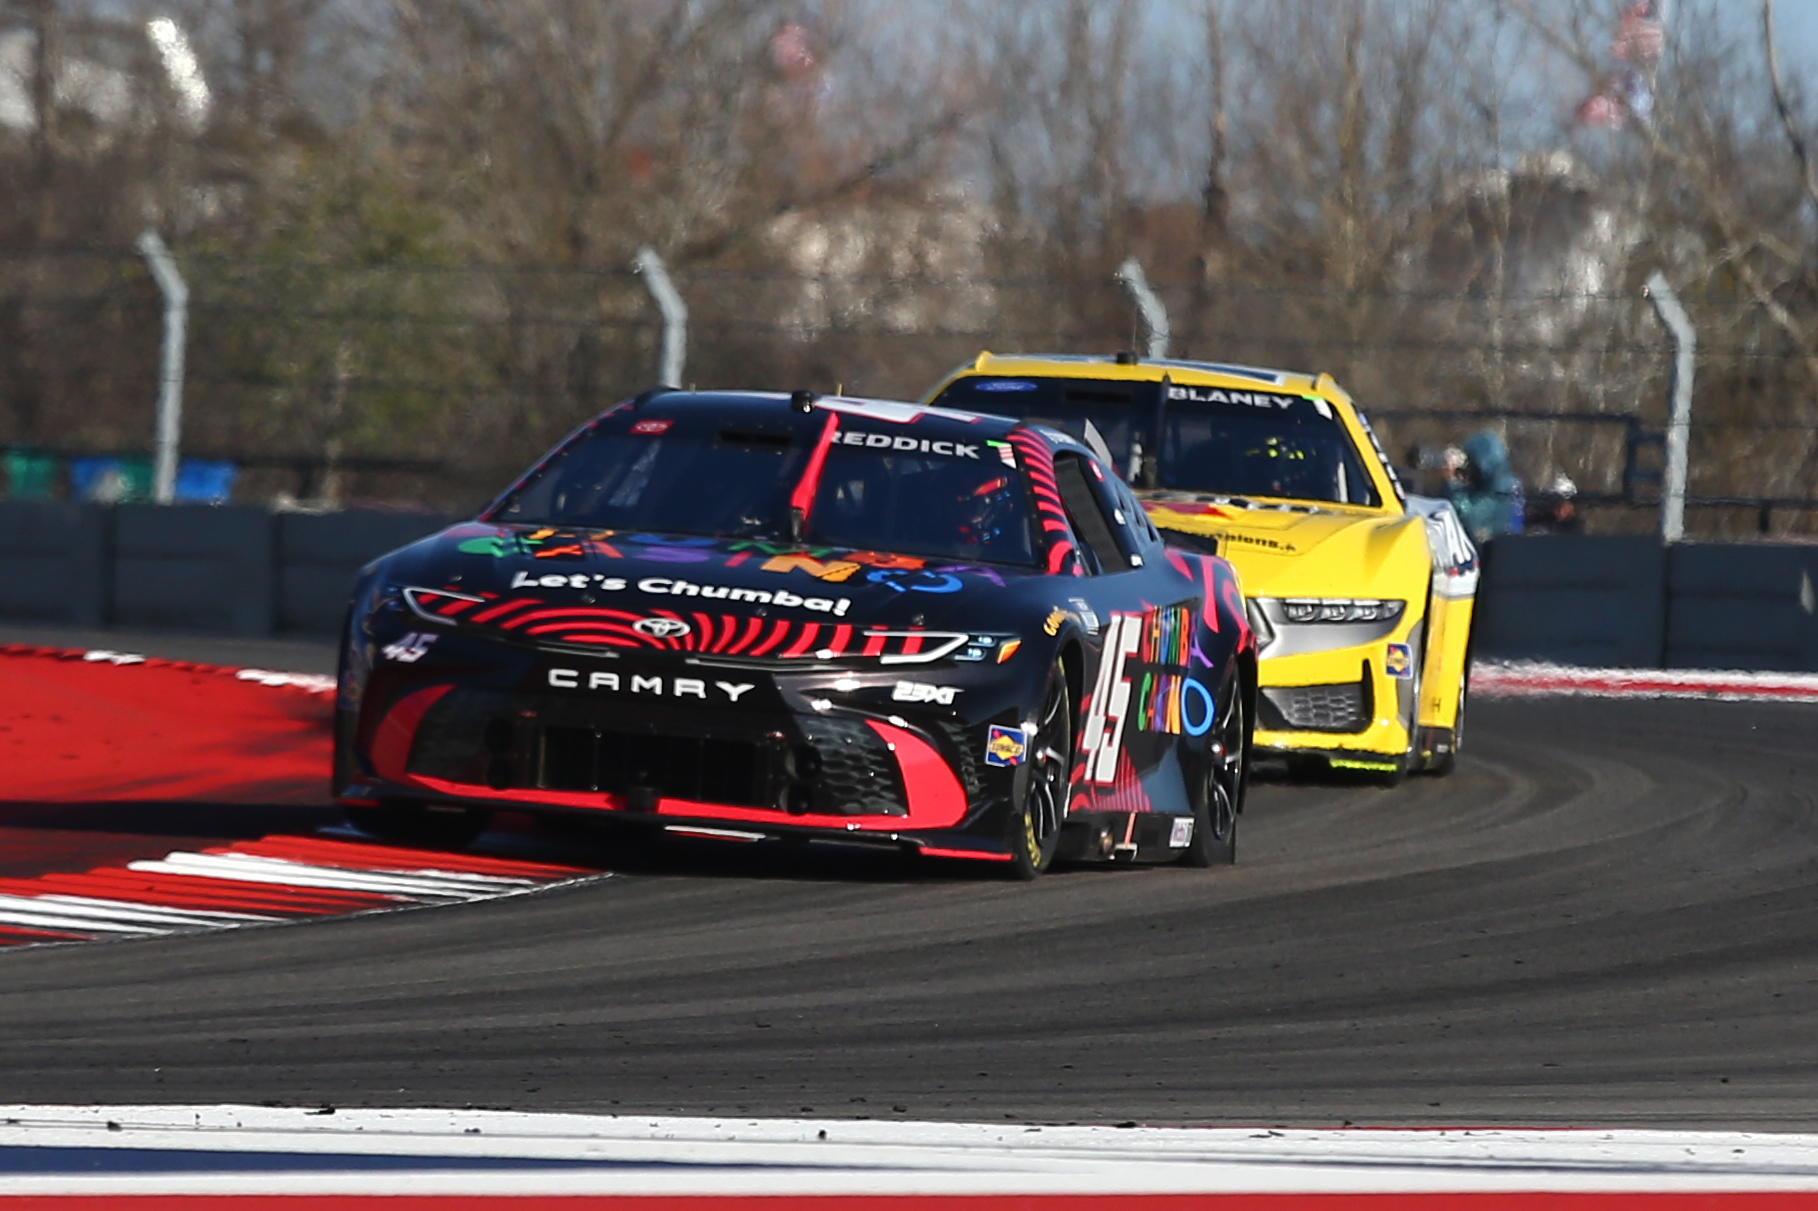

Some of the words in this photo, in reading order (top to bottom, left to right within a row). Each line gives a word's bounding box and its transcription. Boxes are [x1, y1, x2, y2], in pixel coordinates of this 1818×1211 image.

[1168, 387, 1293, 409] BLANEY
[510, 570, 627, 591] Let's
[637, 577, 851, 617] Chumba!
[382, 632, 440, 663] 45
[1142, 605, 1215, 669] CHUMBA
[548, 668, 755, 702] CAMRY
[1082, 611, 1145, 787] 45
[1137, 671, 1215, 736] CASINO
